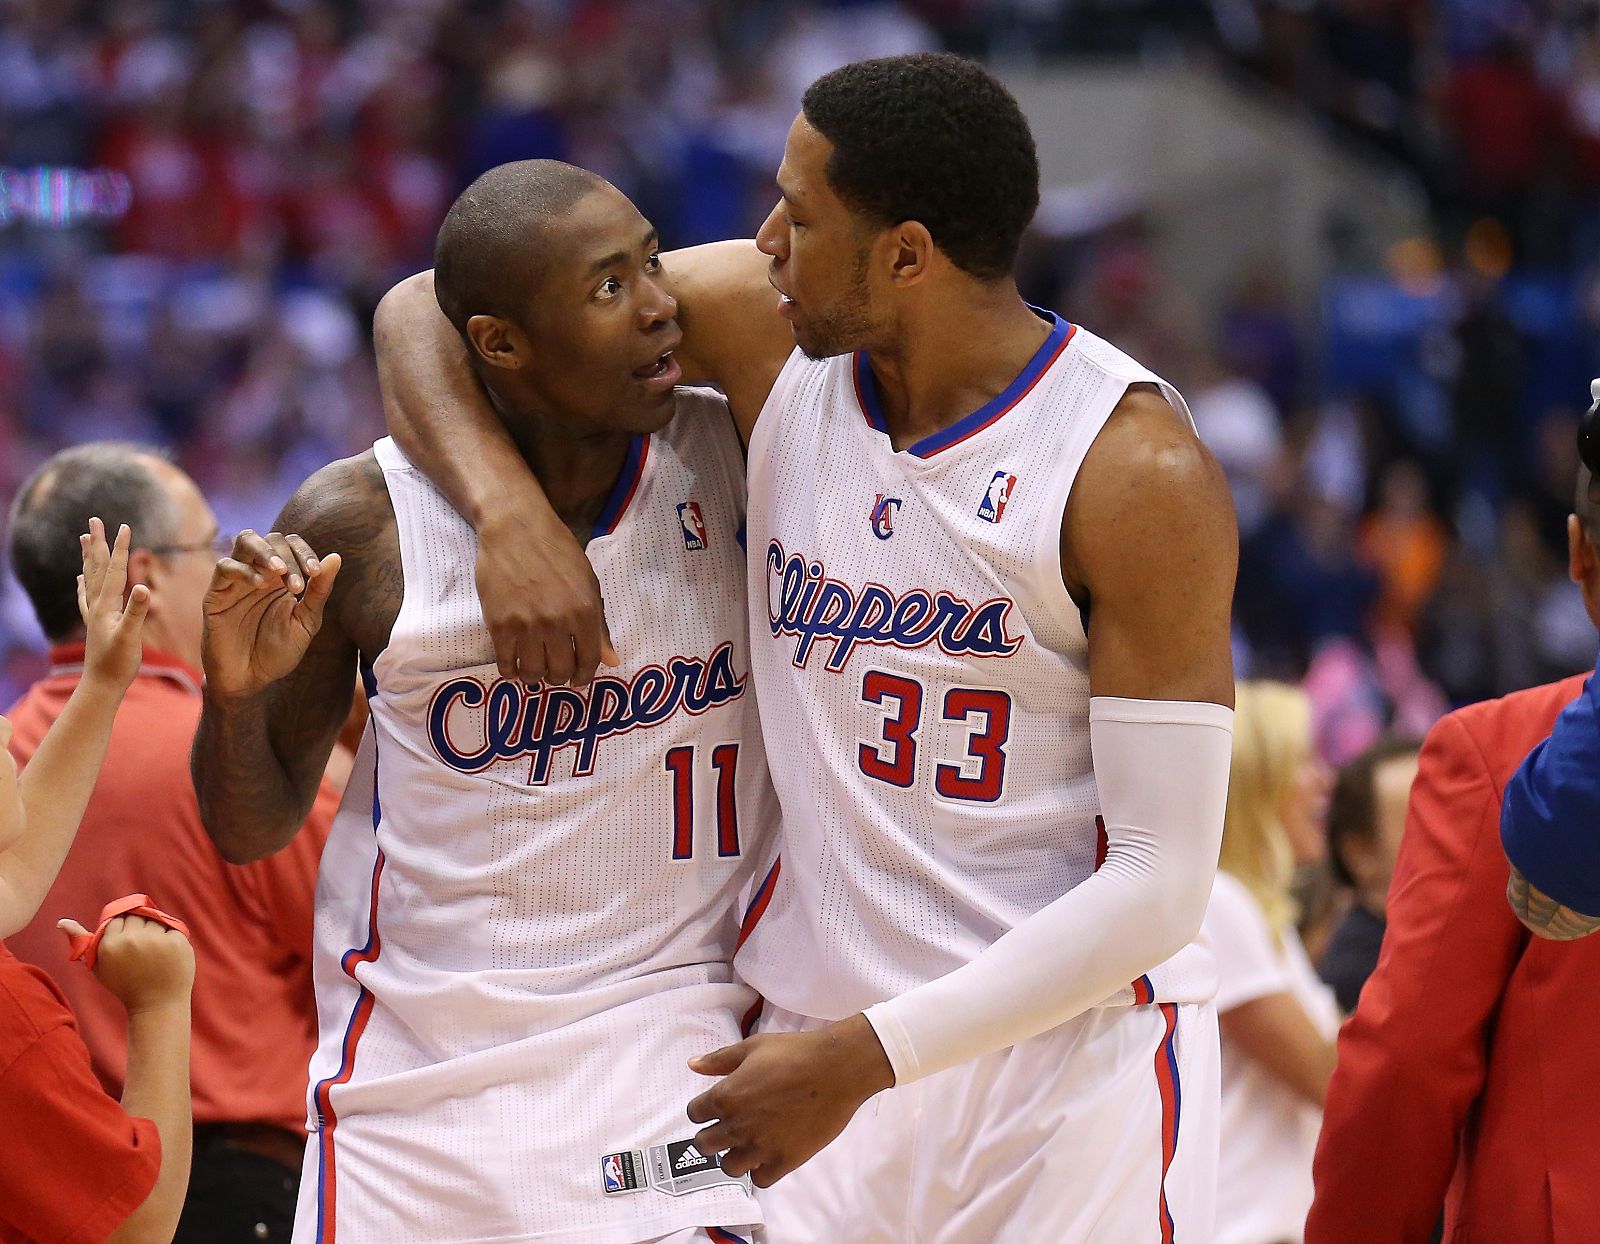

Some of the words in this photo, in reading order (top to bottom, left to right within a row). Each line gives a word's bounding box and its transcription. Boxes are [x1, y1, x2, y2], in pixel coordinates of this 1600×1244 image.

[687, 539, 702, 549] NBA
[978, 507, 995, 520] NBA
[766, 538, 1025, 673] Clippers
[426, 641, 748, 786] Clippers
[857, 667, 1014, 805] 33
[664, 741, 742, 861] 11
[675, 1157, 708, 1170] adidas
